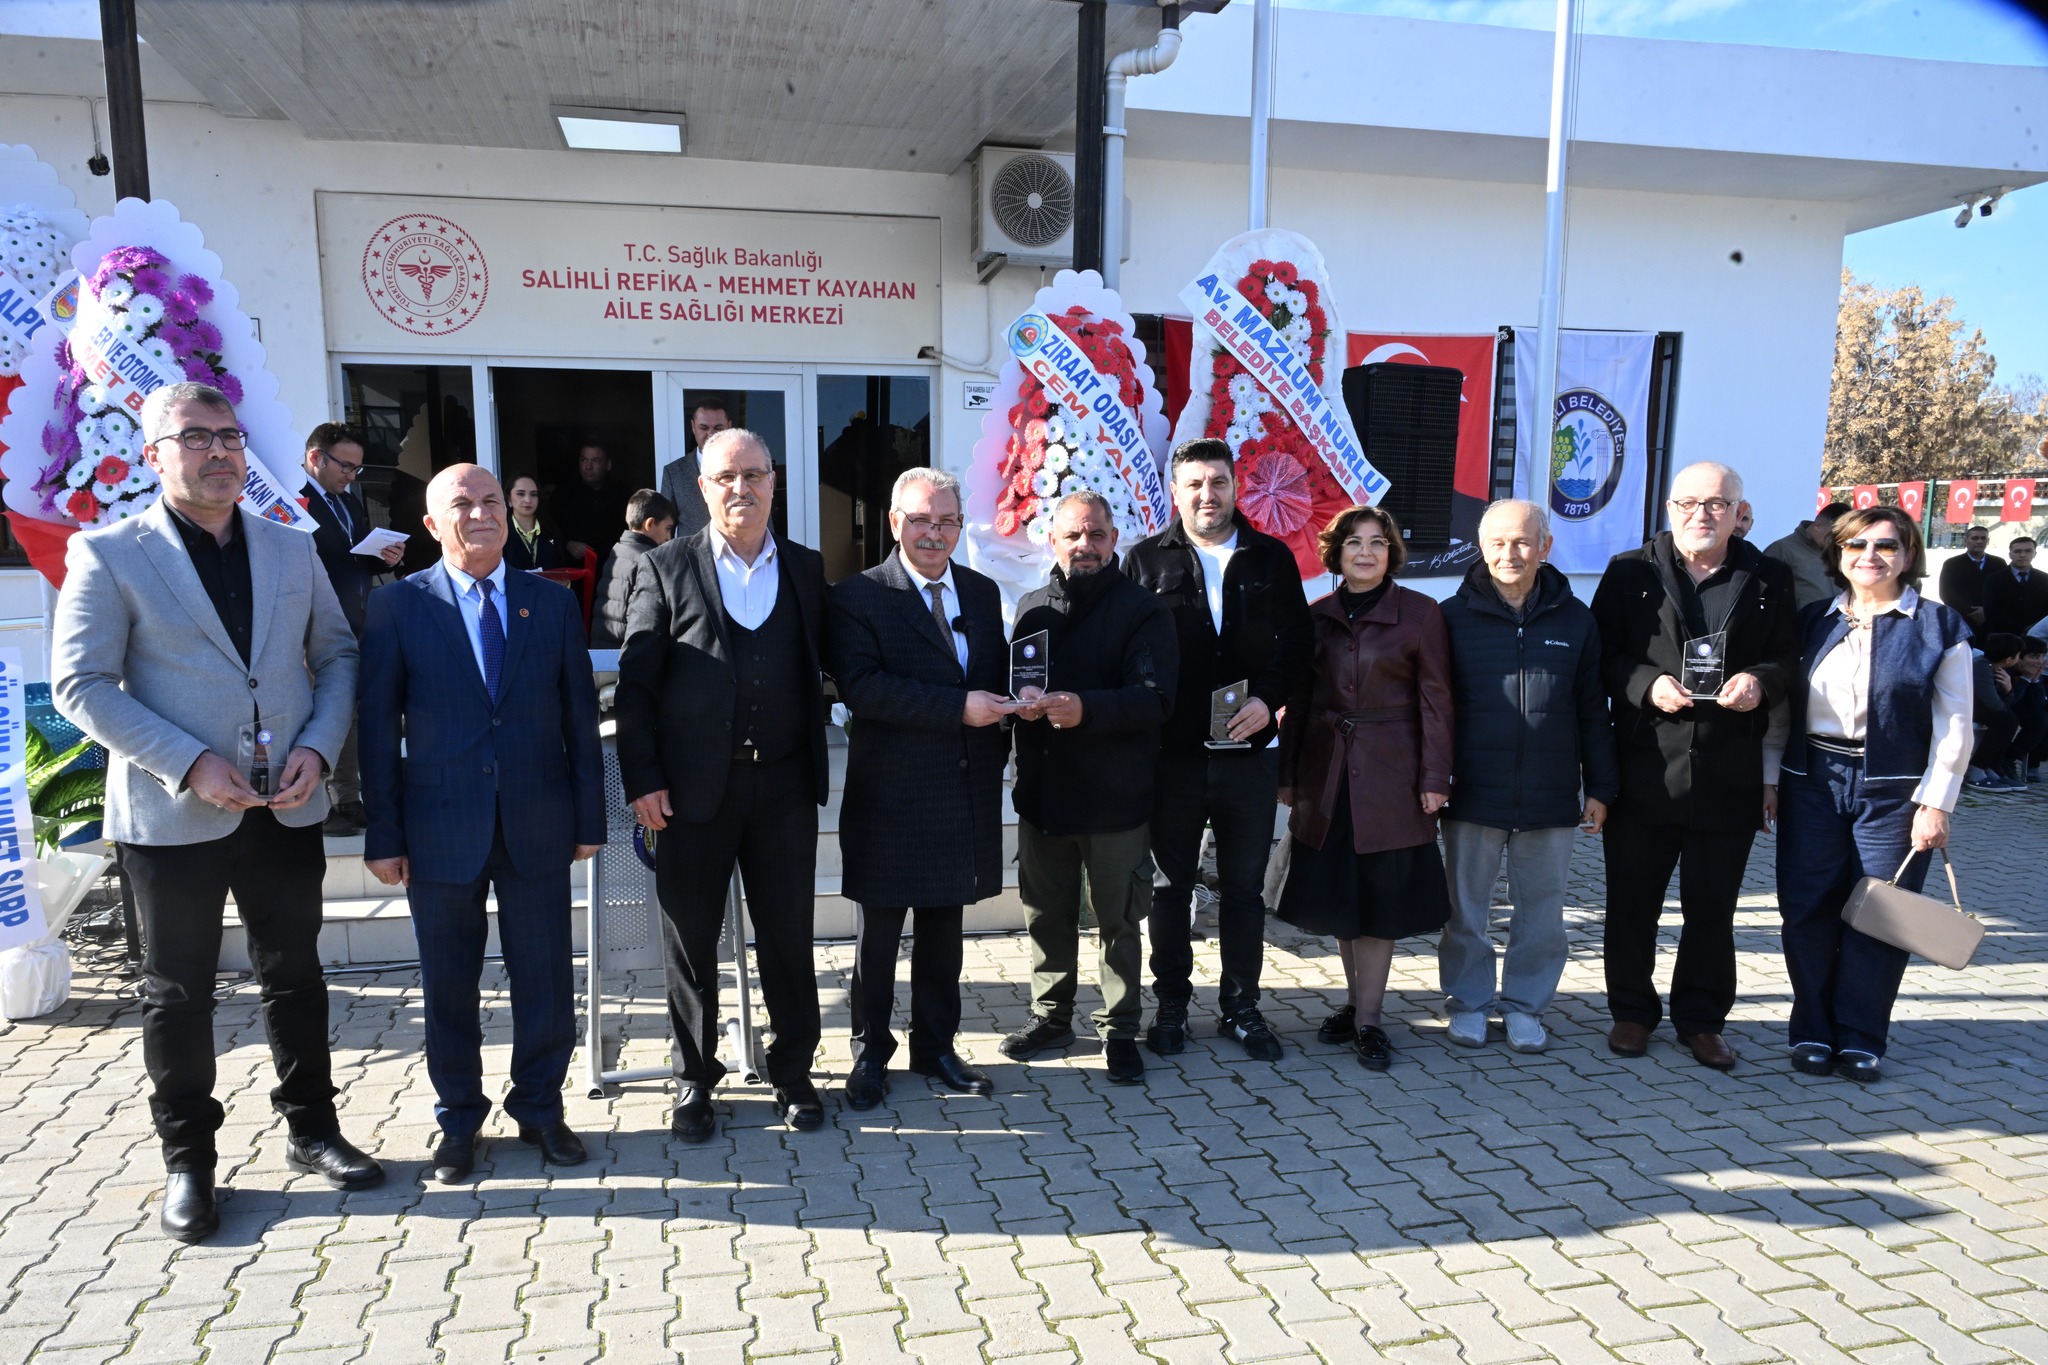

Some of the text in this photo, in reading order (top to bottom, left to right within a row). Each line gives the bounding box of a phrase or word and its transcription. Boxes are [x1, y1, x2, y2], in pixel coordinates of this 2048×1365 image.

[386, 236, 466, 309] TÜRKİYE CUMHURİYETİ SAĞLIK BAKANLIĞI
[522, 266, 610, 290] SALİHLİ
[617, 269, 698, 293] REFİKA
[719, 275, 811, 297] MEHMET
[817, 279, 916, 300] KAYAHAN
[623, 243, 823, 273] T.C. Sağlık Bakanlığı
[604, 297, 843, 325] AİLE SAĞLIĞI MERKEZİ
[105, 337, 129, 364] VE
[1033, 359, 1090, 420] CEM
[1196, 273, 1385, 494] Av. MAZLUM NURLU
[1203, 308, 1353, 486] BELEDİYE BAŞKANI
[1039, 334, 1167, 529] ZİRAAT ODASI BAŞKANI
[1568, 395, 1625, 457] BELEDİYESİ
[1563, 502, 1591, 515] 1879
